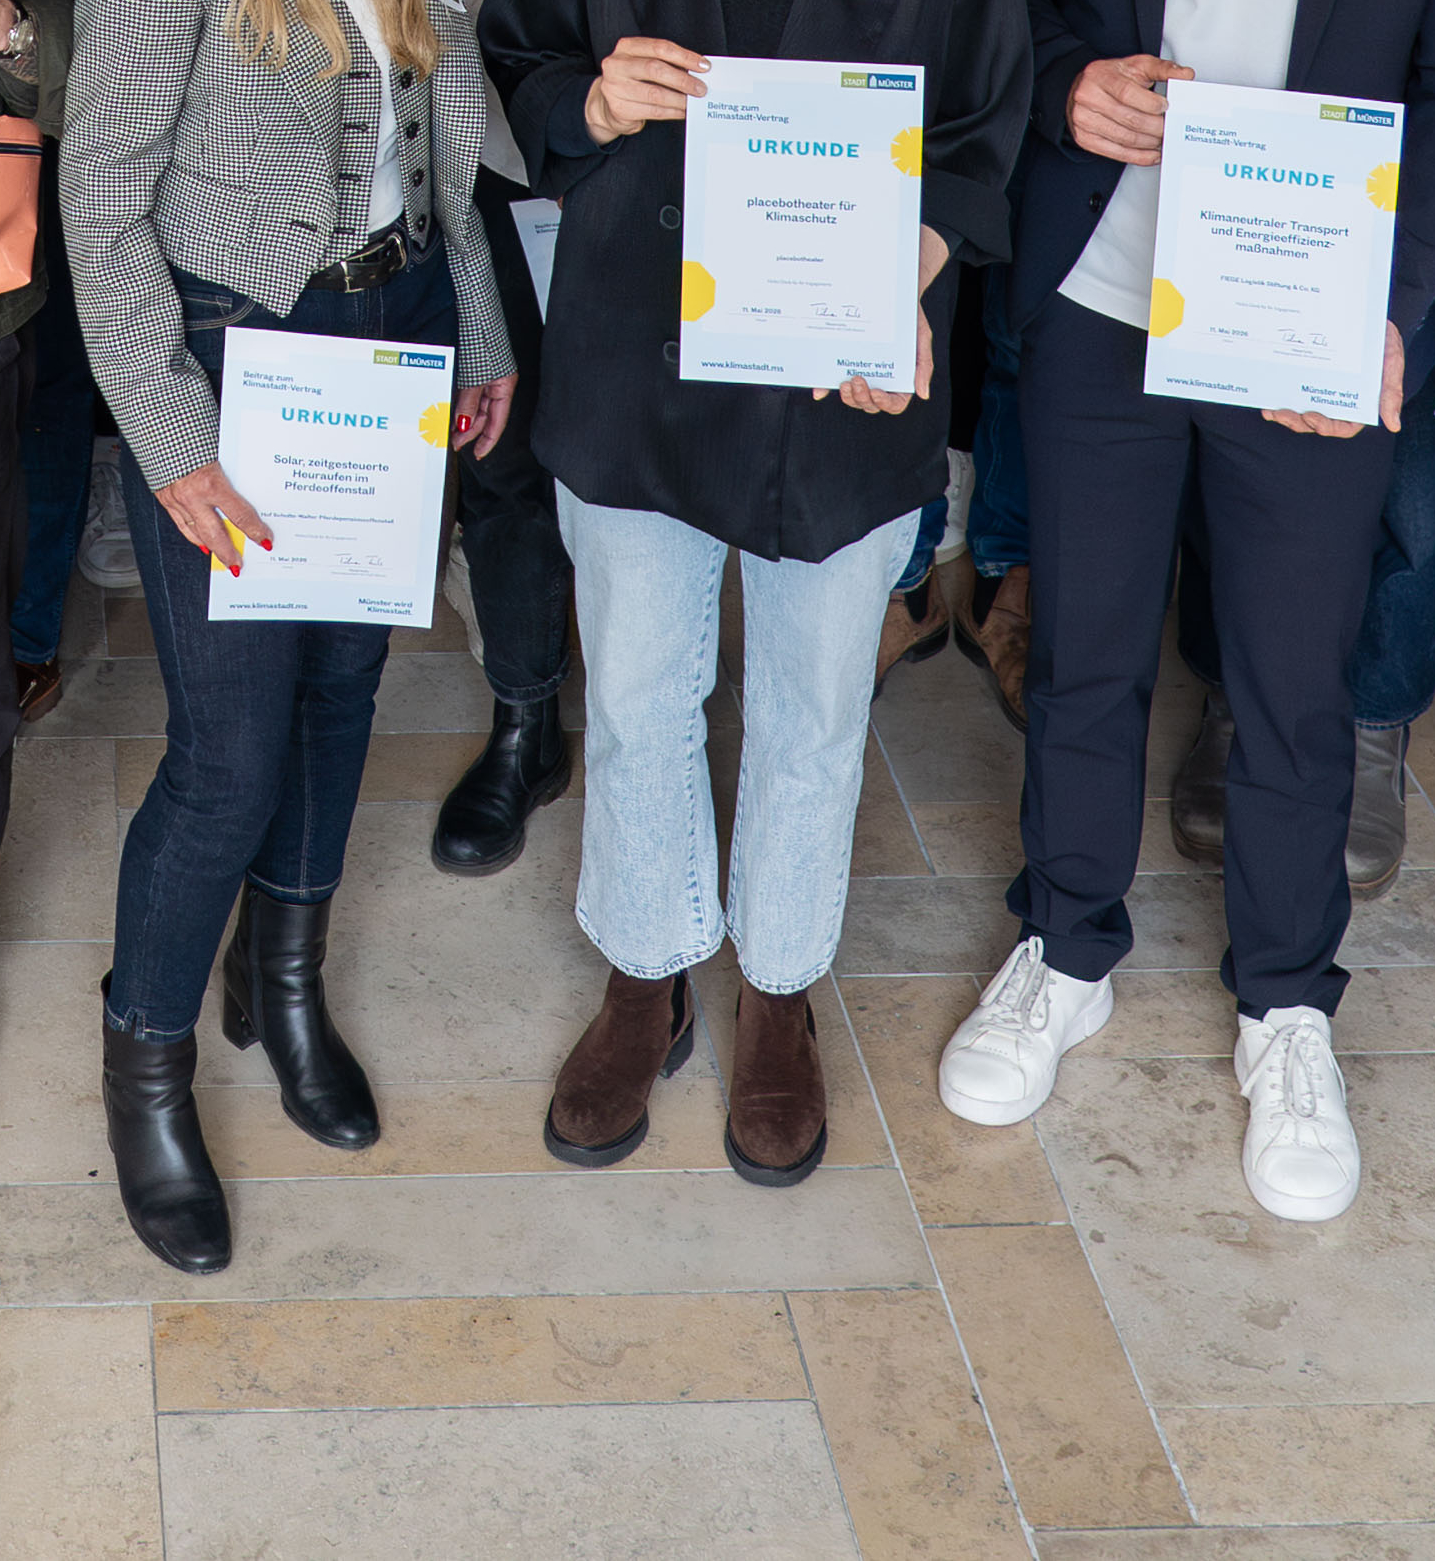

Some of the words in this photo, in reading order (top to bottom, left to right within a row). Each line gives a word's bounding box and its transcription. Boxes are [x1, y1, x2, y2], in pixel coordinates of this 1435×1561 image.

[878, 79, 913, 88] MÜNSTER
[708, 102, 738, 112] Beitrag
[708, 112, 789, 123] Klimastadt-Vertrag
[1357, 114, 1392, 125] MÜNSTER
[1185, 125, 1217, 136] Beitrag
[748, 139, 860, 158] URKUNDE
[1185, 134, 1266, 150] Klimastadt-Vertrag
[1224, 163, 1335, 189] URKUNDE
[747, 197, 835, 211] placebotheater
[839, 201, 856, 211] für
[766, 212, 837, 224] Klimaschutz
[1200, 211, 1287, 229] Klimaneutraler
[1290, 221, 1349, 237] Transport
[1211, 226, 1232, 236] und
[1235, 228, 1336, 248] Energieeffizienz-
[1235, 242, 1309, 259] maßnahmen
[409, 357, 443, 367] MÜNSTER
[701, 359, 784, 372] www.klimastadt.ms
[837, 359, 871, 368] Münster
[875, 360, 894, 369] wird
[243, 371, 271, 382] Beitrag
[243, 380, 322, 395] Klimastadt-Vertrag
[1166, 376, 1248, 394] www.klimastadt.ms
[1301, 385, 1336, 397] Münster
[1339, 389, 1358, 399] wird
[281, 407, 389, 429] URKUNDE
[274, 455, 305, 466] Solar,
[308, 459, 389, 472] zeitgesteuerte
[293, 470, 352, 482] Heuraufen
[355, 474, 369, 483] im
[285, 482, 375, 495] Pferdeoffenstall
[229, 602, 307, 610] www.klimastadt.ms
[358, 599, 391, 607] Münster
